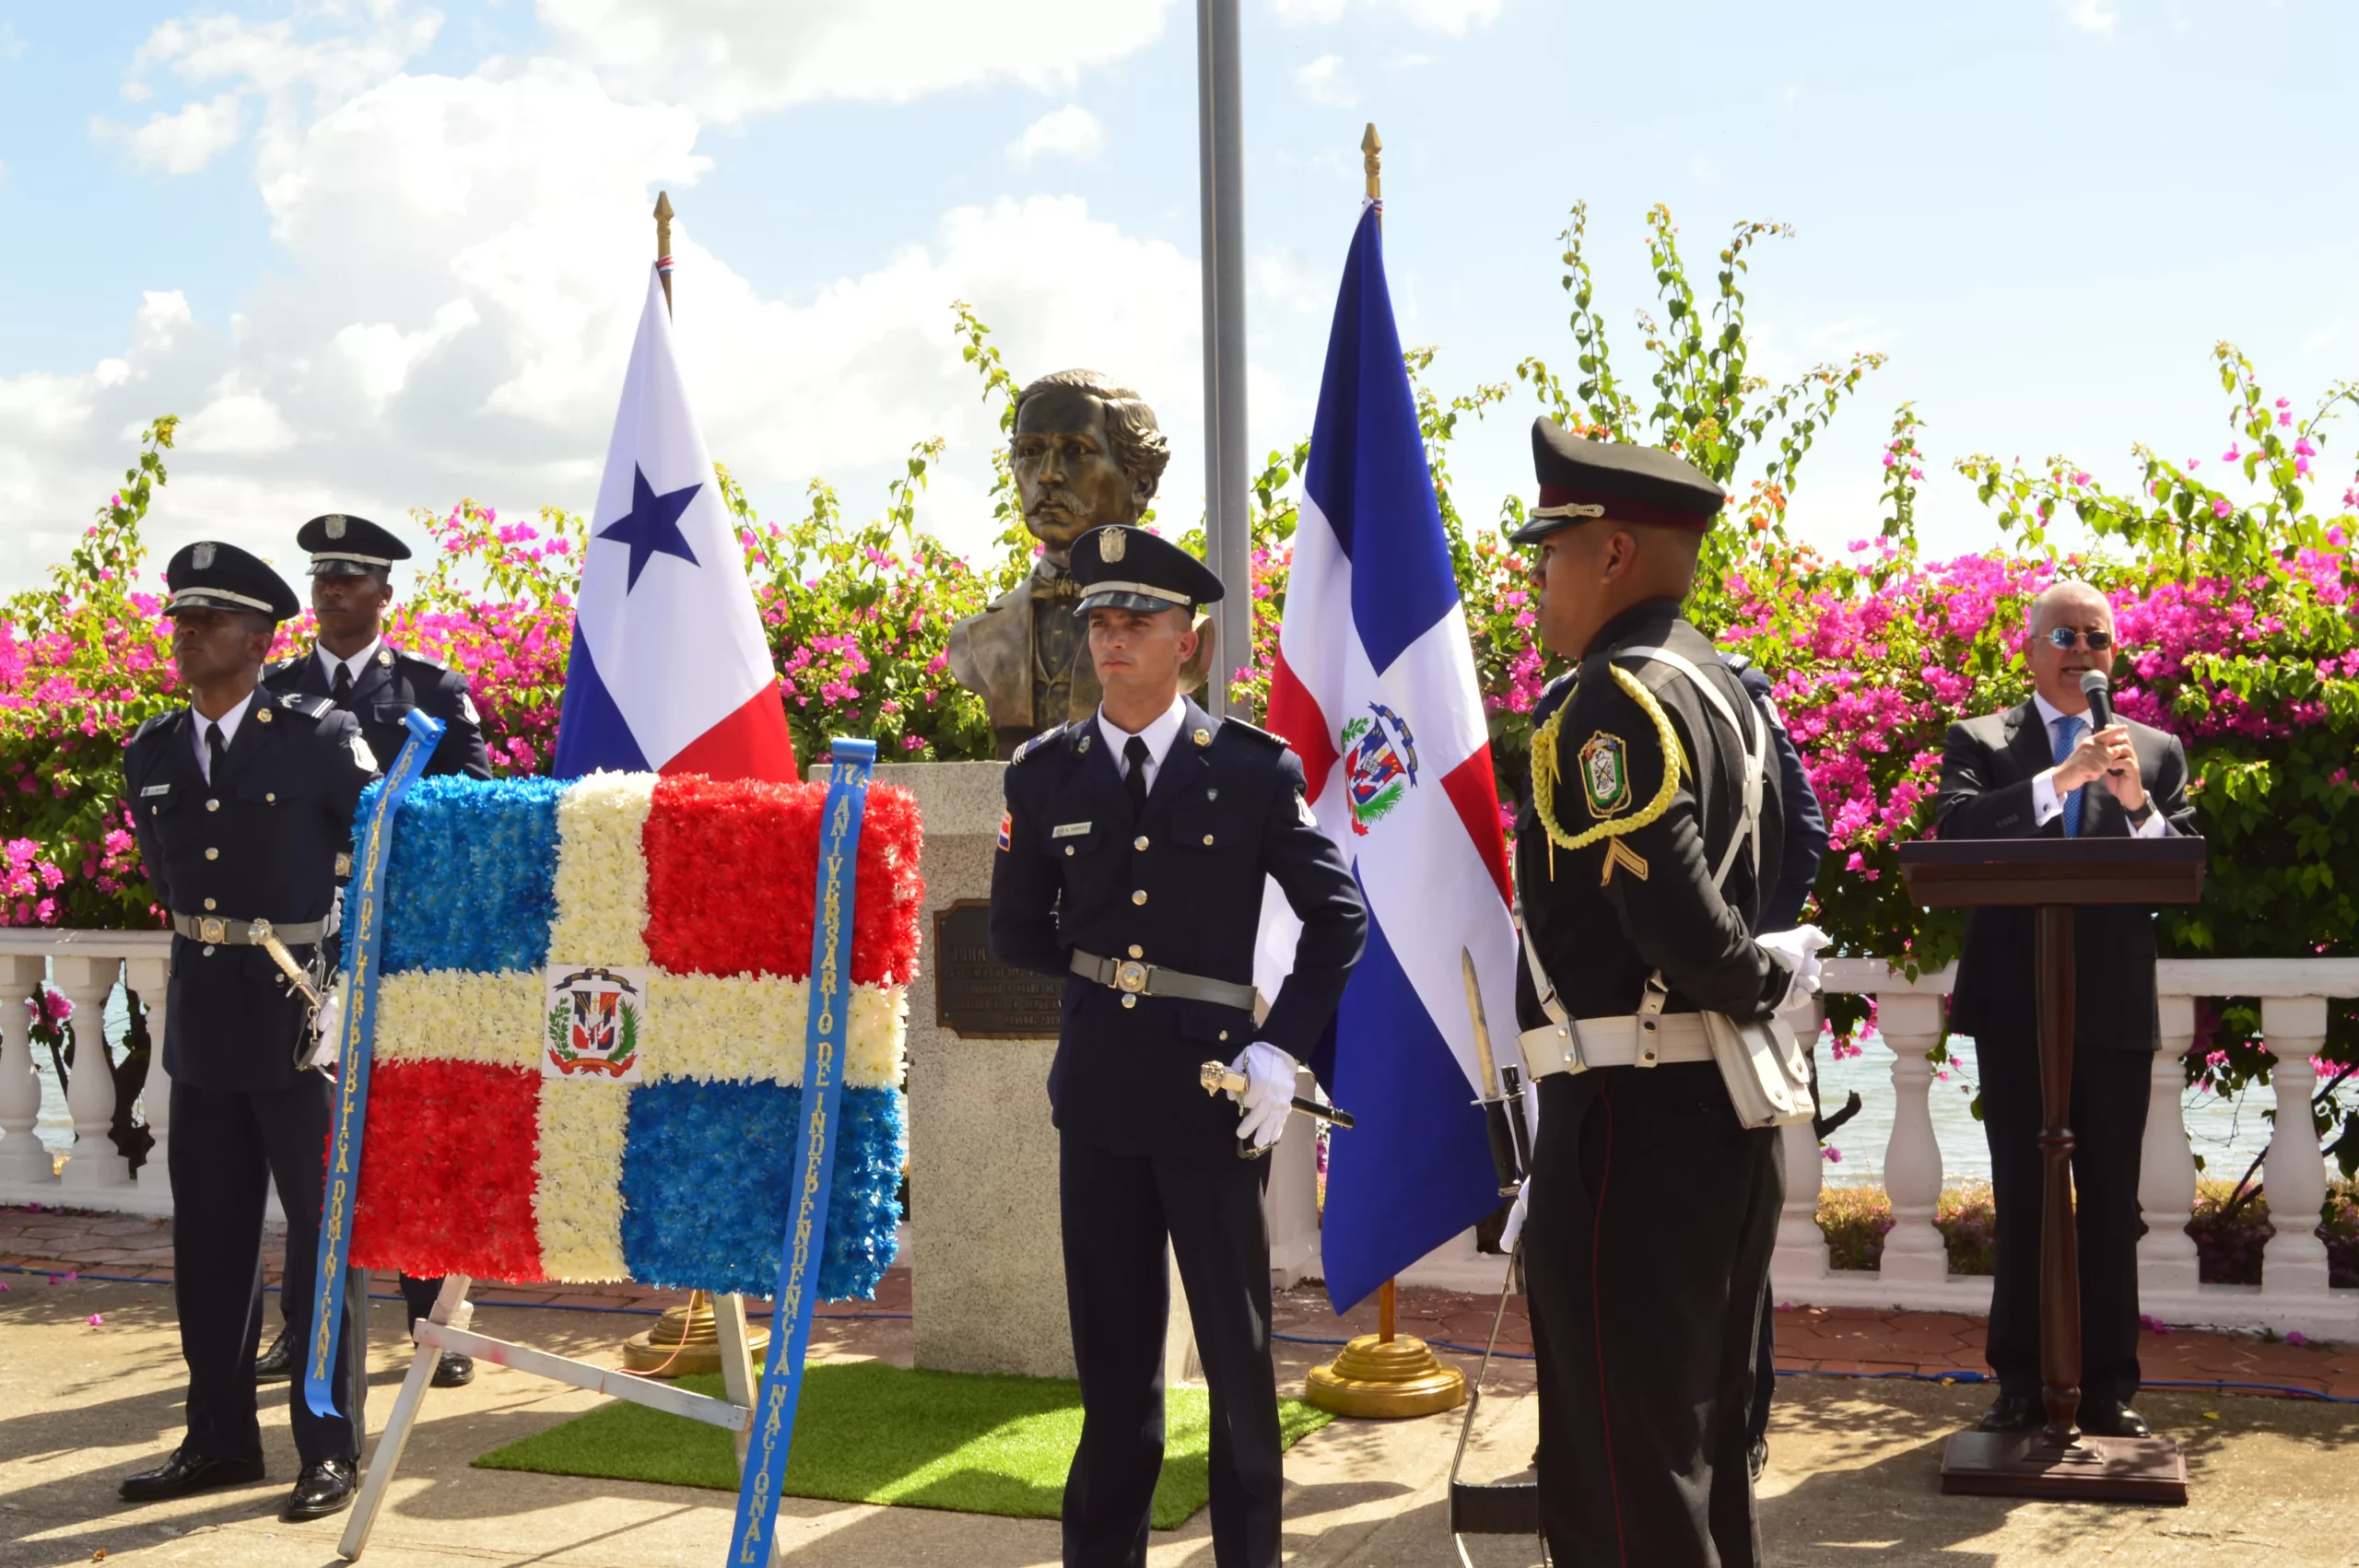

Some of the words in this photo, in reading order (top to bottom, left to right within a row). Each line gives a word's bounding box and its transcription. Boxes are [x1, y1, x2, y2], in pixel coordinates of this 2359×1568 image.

[834, 763, 868, 789] 174
[352, 944, 369, 987] LA
[358, 897, 374, 941] DE
[817, 793, 851, 1036] ANIVERSARIO
[335, 990, 365, 1174] REPUBLICA
[815, 1042, 834, 1087] DE
[312, 1179, 346, 1380] DOMINICANA
[773, 1092, 827, 1376] INDEPENDENCIA
[739, 1385, 788, 1563] NACIONAL
